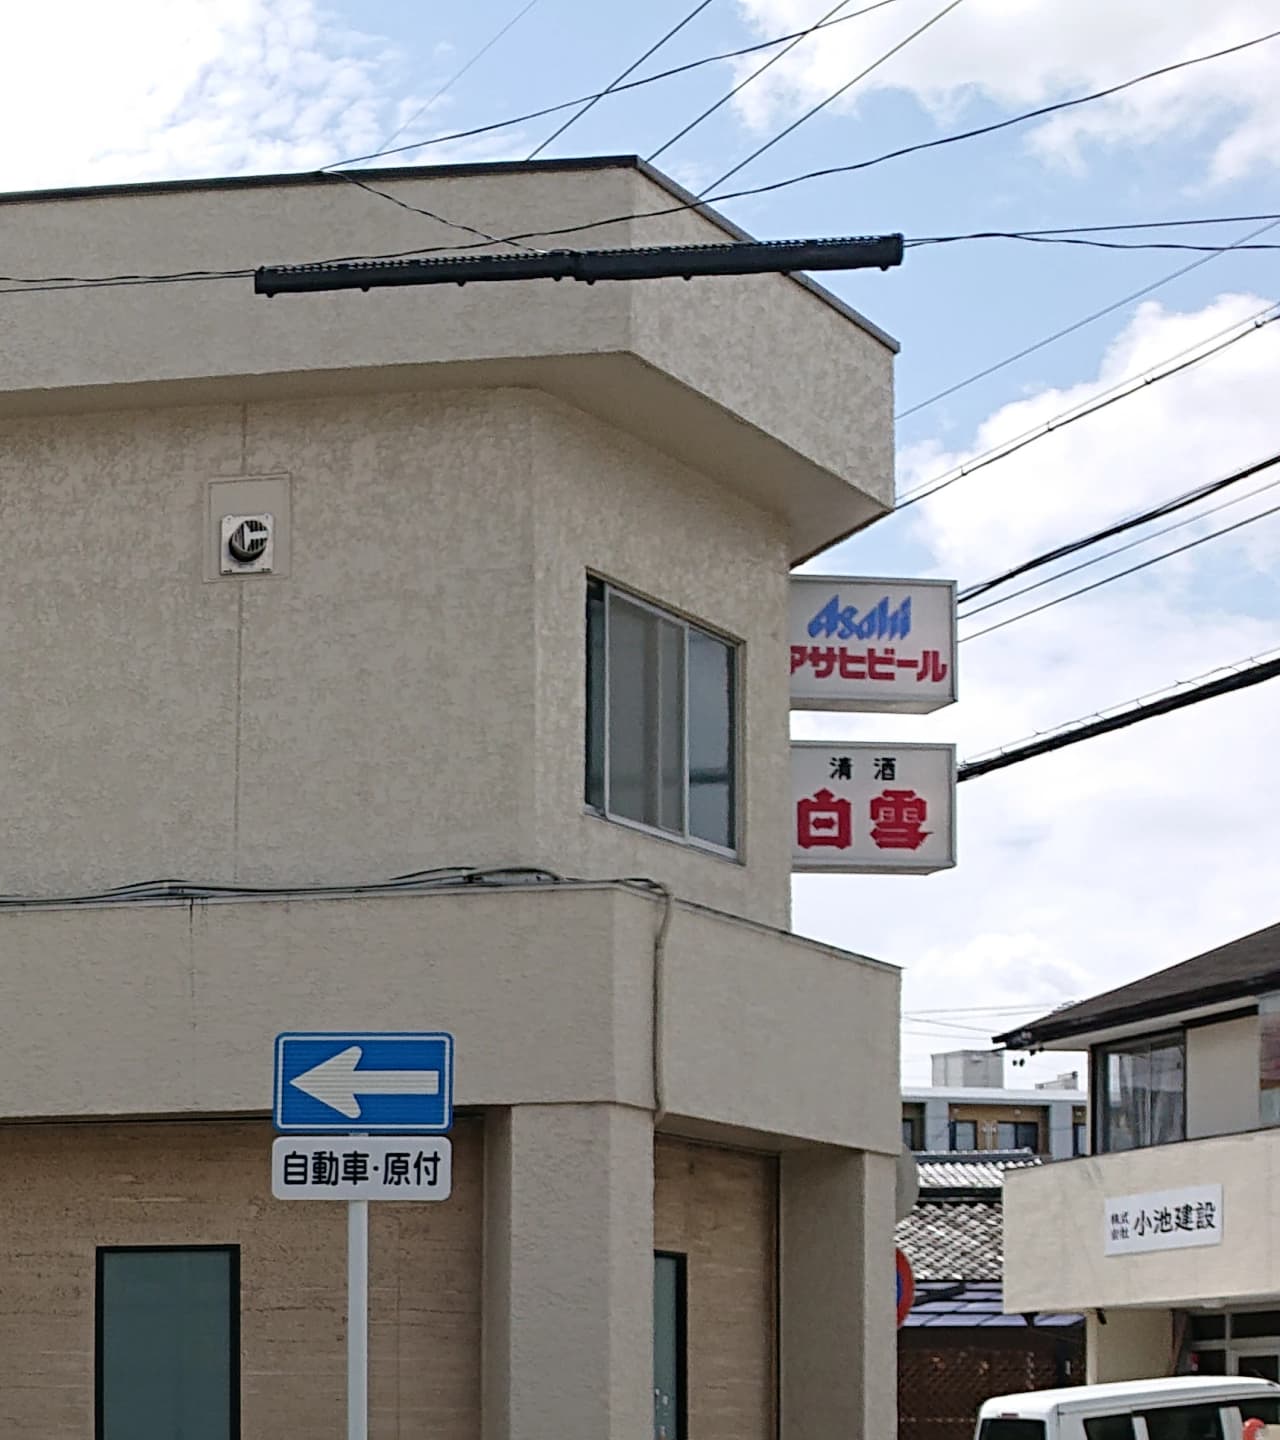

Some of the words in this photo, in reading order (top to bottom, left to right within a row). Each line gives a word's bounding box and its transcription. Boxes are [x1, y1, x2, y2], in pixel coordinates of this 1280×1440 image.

[807, 593, 912, 641] Asahi
[790, 645, 948, 683] アサヒビール
[829, 757, 897, 781] 清酒
[796, 787, 934, 850] 白雪
[1134, 1201, 1216, 1237] 小池建設
